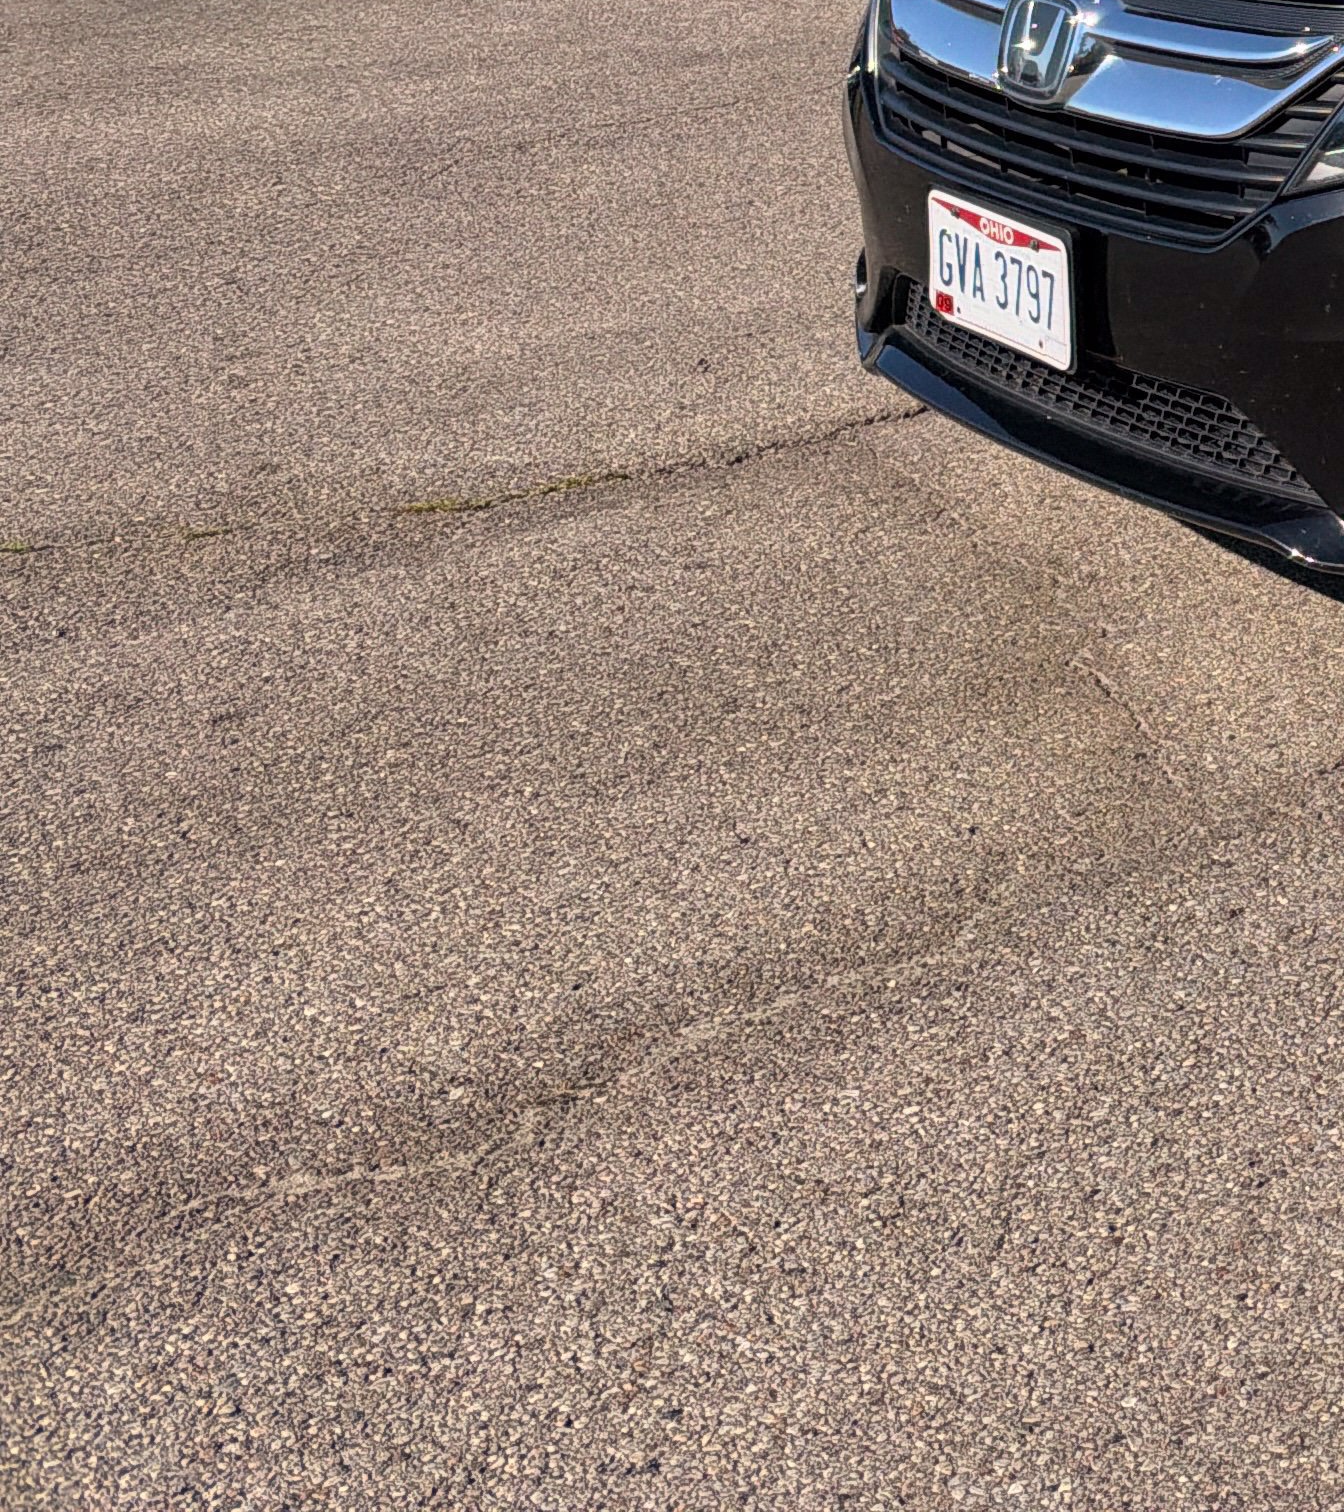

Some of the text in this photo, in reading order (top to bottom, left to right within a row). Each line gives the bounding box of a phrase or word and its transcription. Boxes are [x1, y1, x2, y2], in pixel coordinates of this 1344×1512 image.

[979, 217, 1015, 245] OHIO
[938, 228, 1056, 331] GVA 3797
